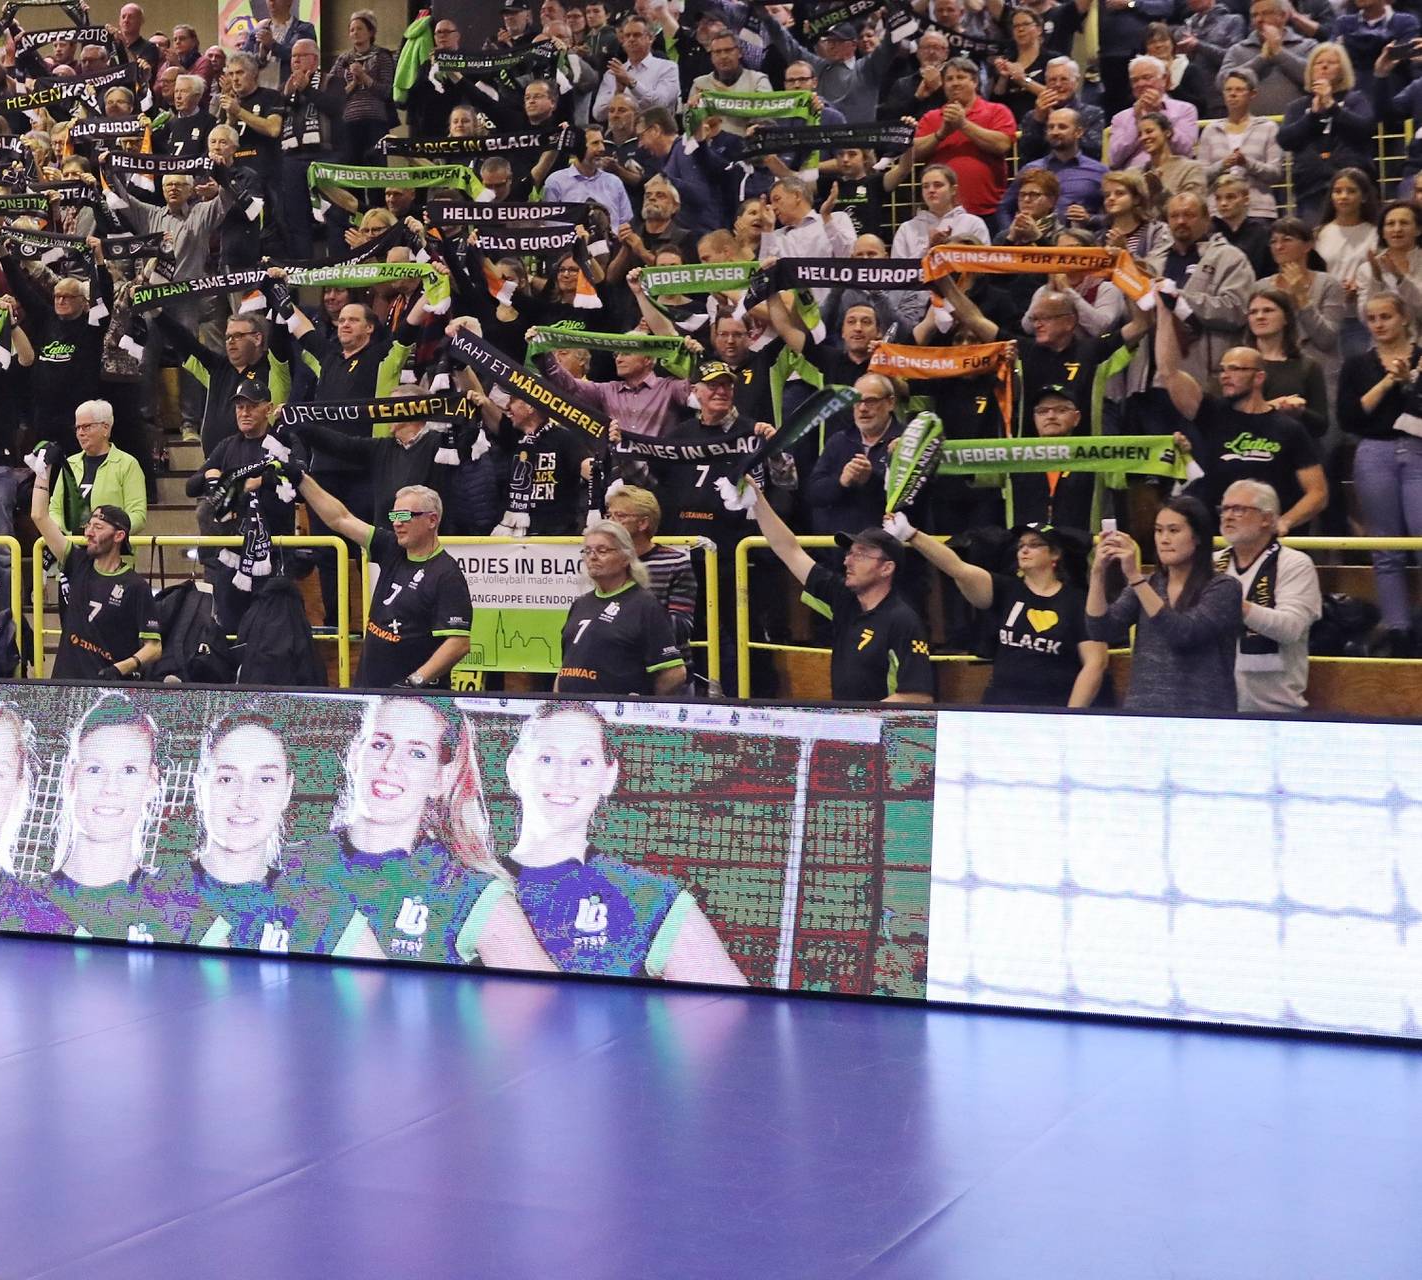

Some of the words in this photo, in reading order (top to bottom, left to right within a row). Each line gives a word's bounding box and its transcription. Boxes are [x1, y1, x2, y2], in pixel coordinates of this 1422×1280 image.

[15, 30, 76, 57] LAYOFFS
[78, 29, 108, 42] 2018
[714, 100, 751, 110] JEDER
[754, 98, 794, 110] FASER
[238, 122, 246, 136] 7
[174, 142, 184, 155] 7
[486, 134, 540, 150] BLACK
[112, 155, 154, 171] HELLO
[315, 169, 331, 179] MIT
[334, 169, 370, 181] JEDER
[371, 170, 410, 181] FASER
[412, 169, 460, 181] AACHEN
[442, 207, 492, 220] HELLO
[1021, 252, 1051, 265] FÜR
[156, 282, 190, 299] TEAM
[192, 275, 226, 291] SAME
[227, 270, 266, 285] SPIRIT
[308, 269, 340, 284] JEDER
[342, 266, 378, 279] FASER
[378, 266, 423, 279] AACHEN
[646, 271, 691, 288] JEDER
[694, 267, 745, 281] FASER
[797, 267, 852, 282] HELLO
[963, 356, 991, 368] FÜR
[452, 335, 491, 364] MAHT
[491, 359, 509, 376] ET
[508, 368, 605, 439] MÄDDCHERE!
[281, 404, 359, 427] UREGIO
[616, 439, 679, 460] LADIES
[681, 446, 704, 460] IN
[708, 437, 759, 456] BLAC
[957, 447, 1008, 465] JEDER
[1012, 445, 1071, 461] FASER
[1074, 446, 1150, 460] AACHEN
[695, 464, 710, 488] 7
[458, 558, 508, 574] ADIES
[515, 558, 534, 574] IN
[542, 558, 582, 575] BLA
[467, 575, 525, 586] ga-Volleyball
[527, 576, 552, 585] made
[555, 576, 564, 585] in
[383, 582, 403, 606] 7
[471, 594, 523, 604] ANGRUPPE
[87, 600, 103, 622] 7
[1005, 600, 1025, 627] I
[367, 621, 402, 644] STAWAG
[573, 619, 591, 644] 7
[857, 630, 874, 650] 7
[999, 629, 1062, 655] BLACK
